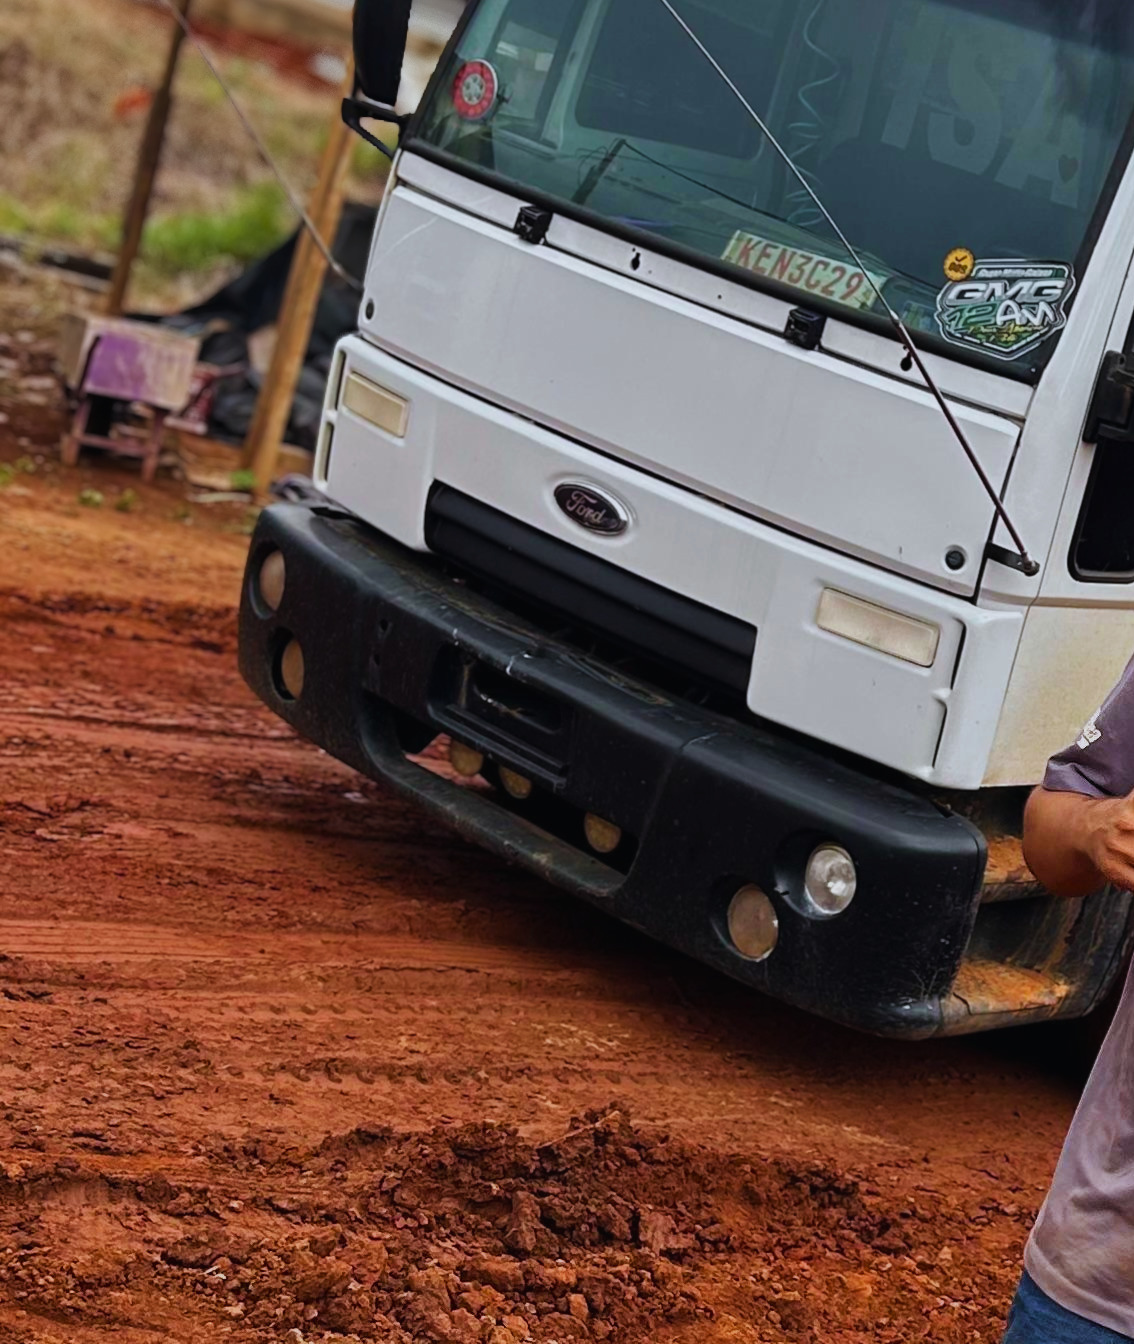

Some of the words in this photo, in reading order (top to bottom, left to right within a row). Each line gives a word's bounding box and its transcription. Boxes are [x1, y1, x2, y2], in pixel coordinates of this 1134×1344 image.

[737, 237, 865, 302] KEN3C29
[946, 279, 1067, 305] GMG
[565, 490, 607, 524] Ford
